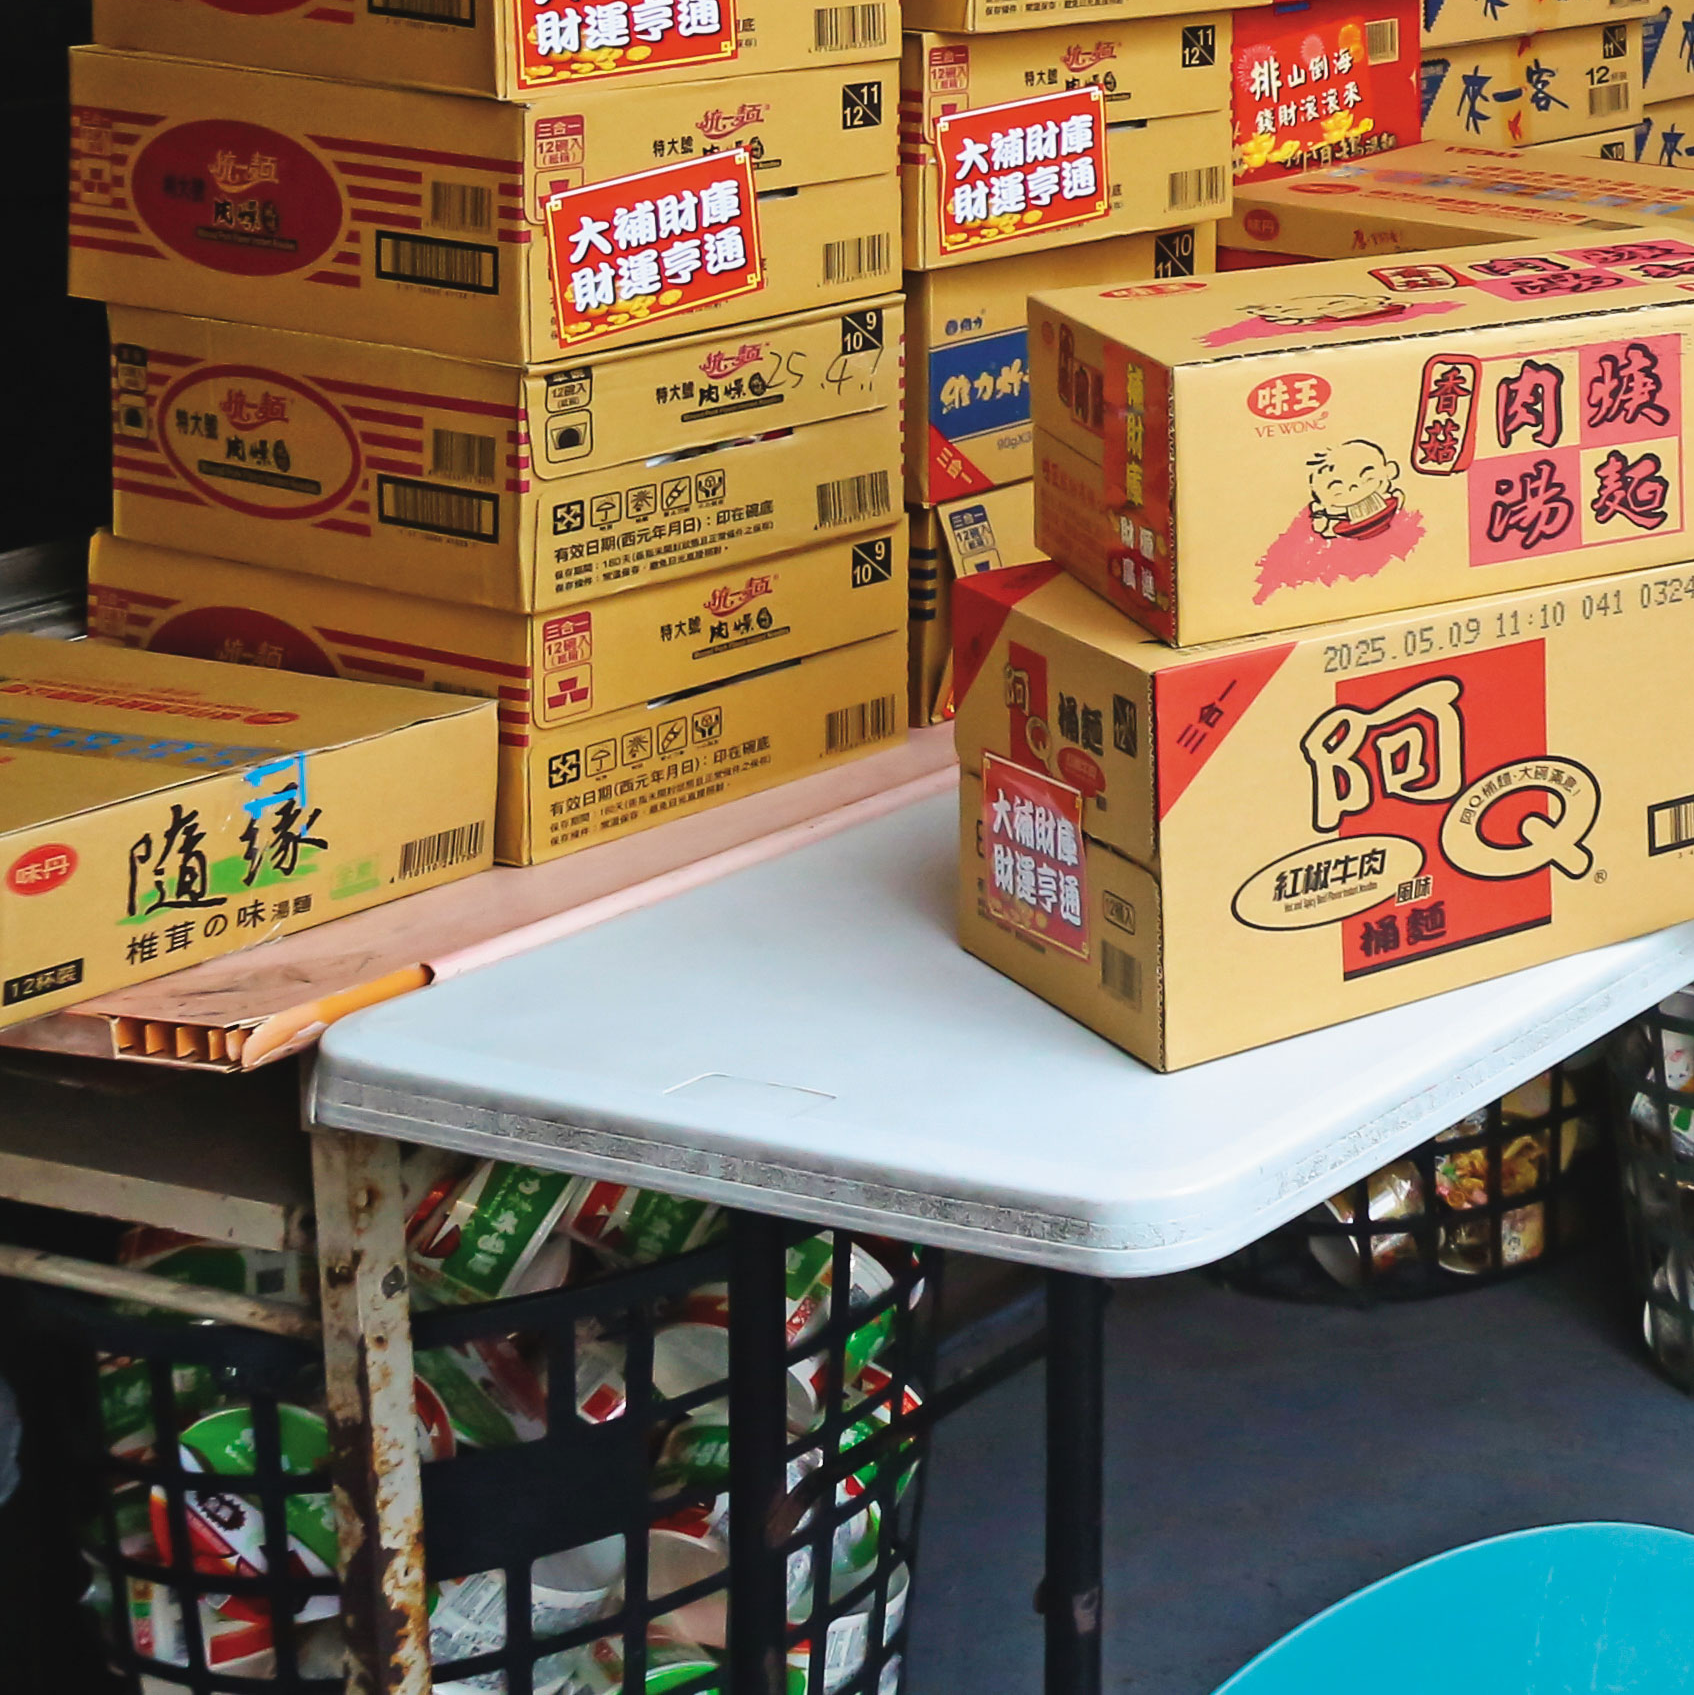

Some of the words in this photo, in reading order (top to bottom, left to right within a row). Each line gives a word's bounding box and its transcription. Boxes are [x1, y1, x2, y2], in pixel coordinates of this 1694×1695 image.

[930, 48, 966, 65] 三合一
[1062, 41, 1118, 73] 統一麵
[1184, 47, 1203, 66] 12
[1197, 28, 1214, 46] 11
[860, 83, 880, 105] 11
[1249, 47, 1354, 104] 排山倒海
[843, 106, 865, 127] 12
[1254, 81, 1363, 135] 錢財滾滾來
[1456, 58, 1569, 135] 來一客
[537, 121, 583, 137] 三合一
[695, 103, 767, 140] 統一麵
[955, 113, 1094, 181] 大補財庫
[954, 156, 1097, 225] 財運亨通
[568, 179, 741, 264] 大補財庫
[1175, 232, 1192, 256] 10
[570, 226, 747, 313] 財運亨通
[865, 311, 879, 331] 9
[699, 342, 766, 380] 統一麵
[844, 332, 864, 353] 10
[940, 358, 1030, 415] 維力炸
[1256, 379, 1322, 417] 味王
[219, 388, 291, 432] 統一麵
[1253, 426, 1275, 439] VE
[1276, 414, 1324, 437] WONG
[1419, 365, 1472, 468] 香菇
[1485, 448, 1670, 550] 湯麵
[873, 541, 886, 562] 9
[853, 563, 875, 586] 10
[545, 618, 590, 641] 三合一
[1323, 617, 1483, 675] 2025.05.09
[1495, 600, 1568, 640] 11:10
[1580, 592, 1624, 622] 041
[1178, 679, 1240, 754] 三合一
[1298, 674, 1601, 881] 阿Q
[991, 788, 1079, 868] 大補財庫
[15, 854, 70, 885] 味丹
[127, 782, 329, 919] 隨緣
[992, 843, 1083, 928] 財運亨通
[1272, 847, 1388, 902] 紅椒牛肉
[1396, 876, 1432, 905] 風味
[1360, 901, 1448, 958] 桶麵
